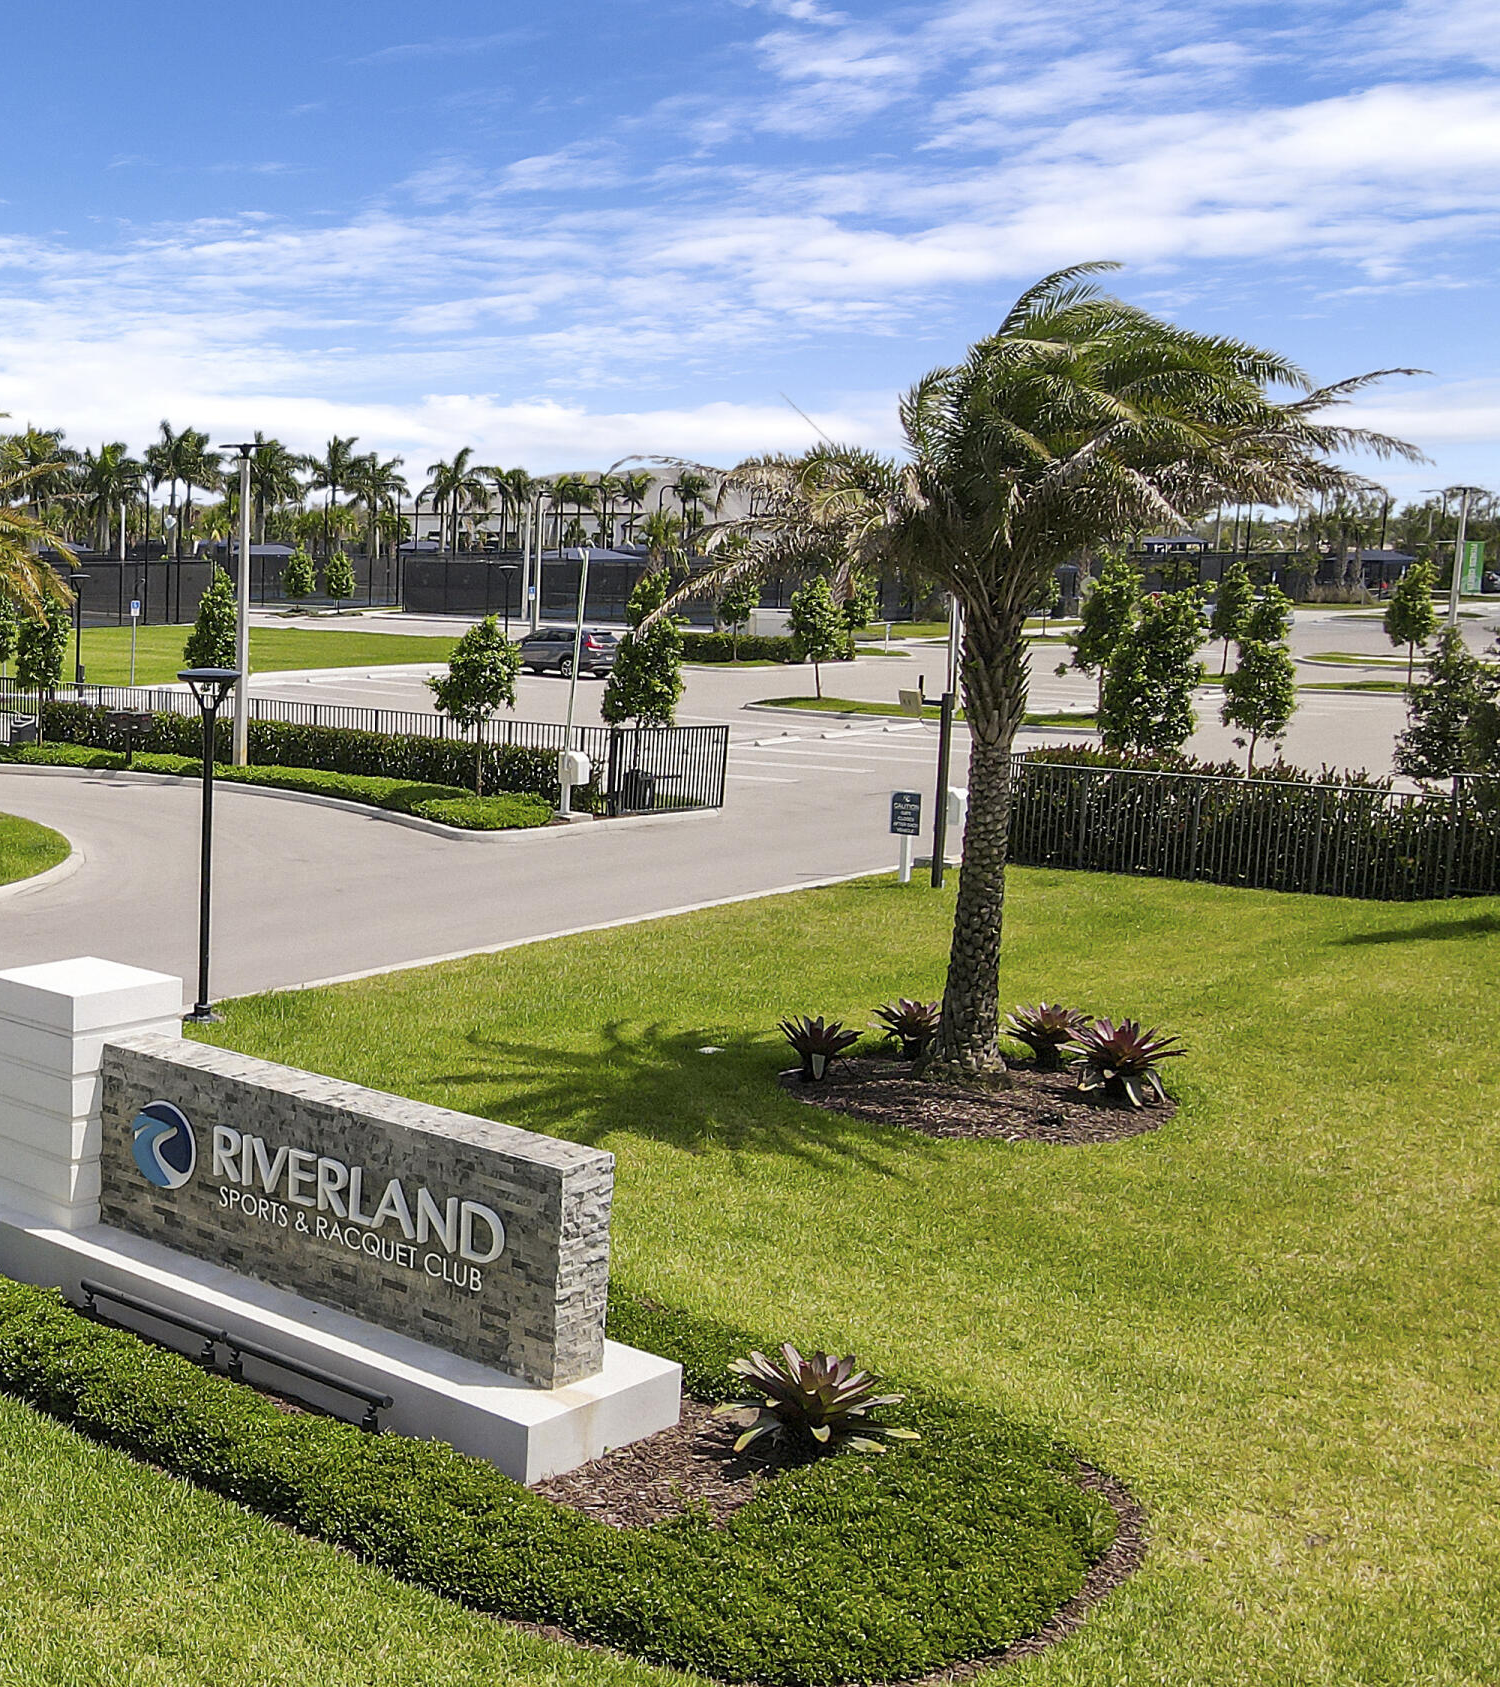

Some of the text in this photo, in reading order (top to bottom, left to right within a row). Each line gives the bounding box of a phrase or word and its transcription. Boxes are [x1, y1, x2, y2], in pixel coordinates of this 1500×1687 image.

[212, 1124, 505, 1264] RIVERLAND
[219, 1186, 483, 1292] SPORTS & RACQUET CLUB
